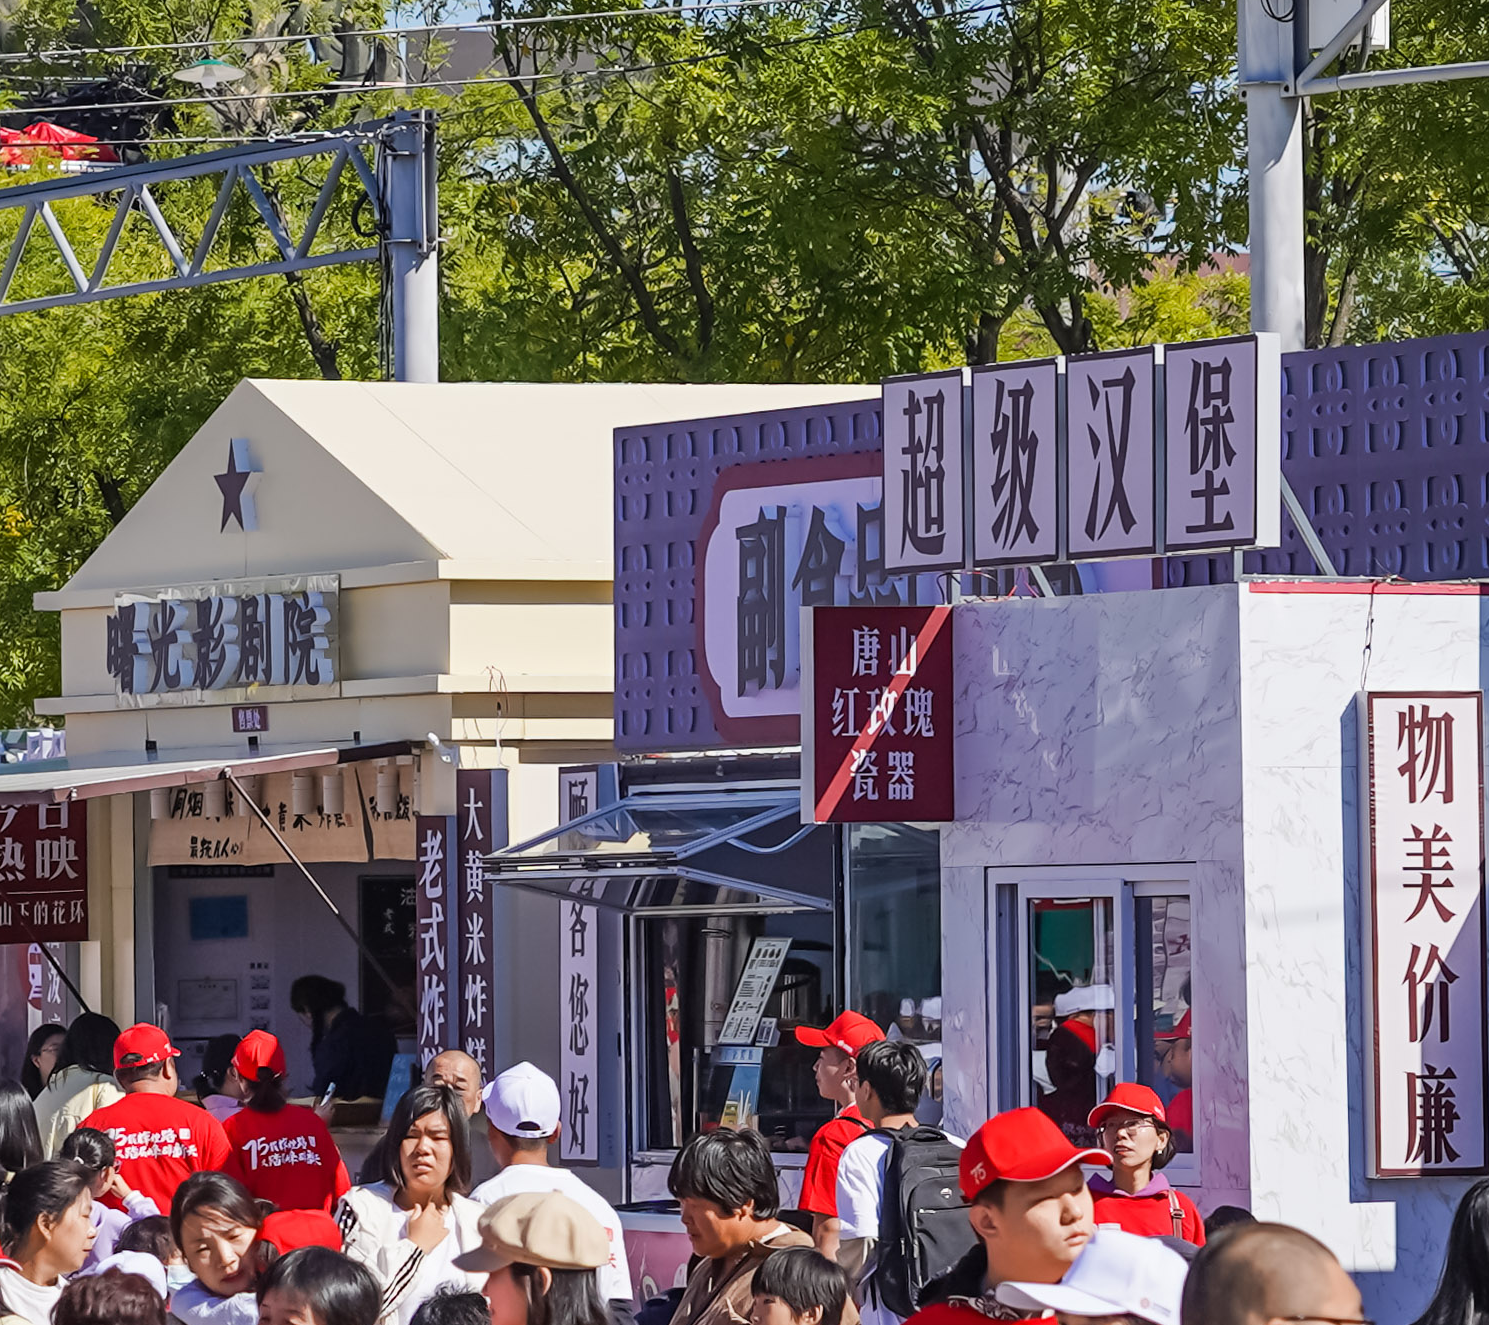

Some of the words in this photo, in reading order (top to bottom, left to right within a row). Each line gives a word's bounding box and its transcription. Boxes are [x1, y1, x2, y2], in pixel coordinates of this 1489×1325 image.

[900, 357, 1236, 557] 超级汉堡
[107, 591, 325, 694] 曙光影剧院
[850, 626, 918, 679] 唐山
[831, 686, 935, 739] 红玫瑰
[849, 750, 916, 802] 瓷器
[1397, 703, 1461, 1166] 物美价廉
